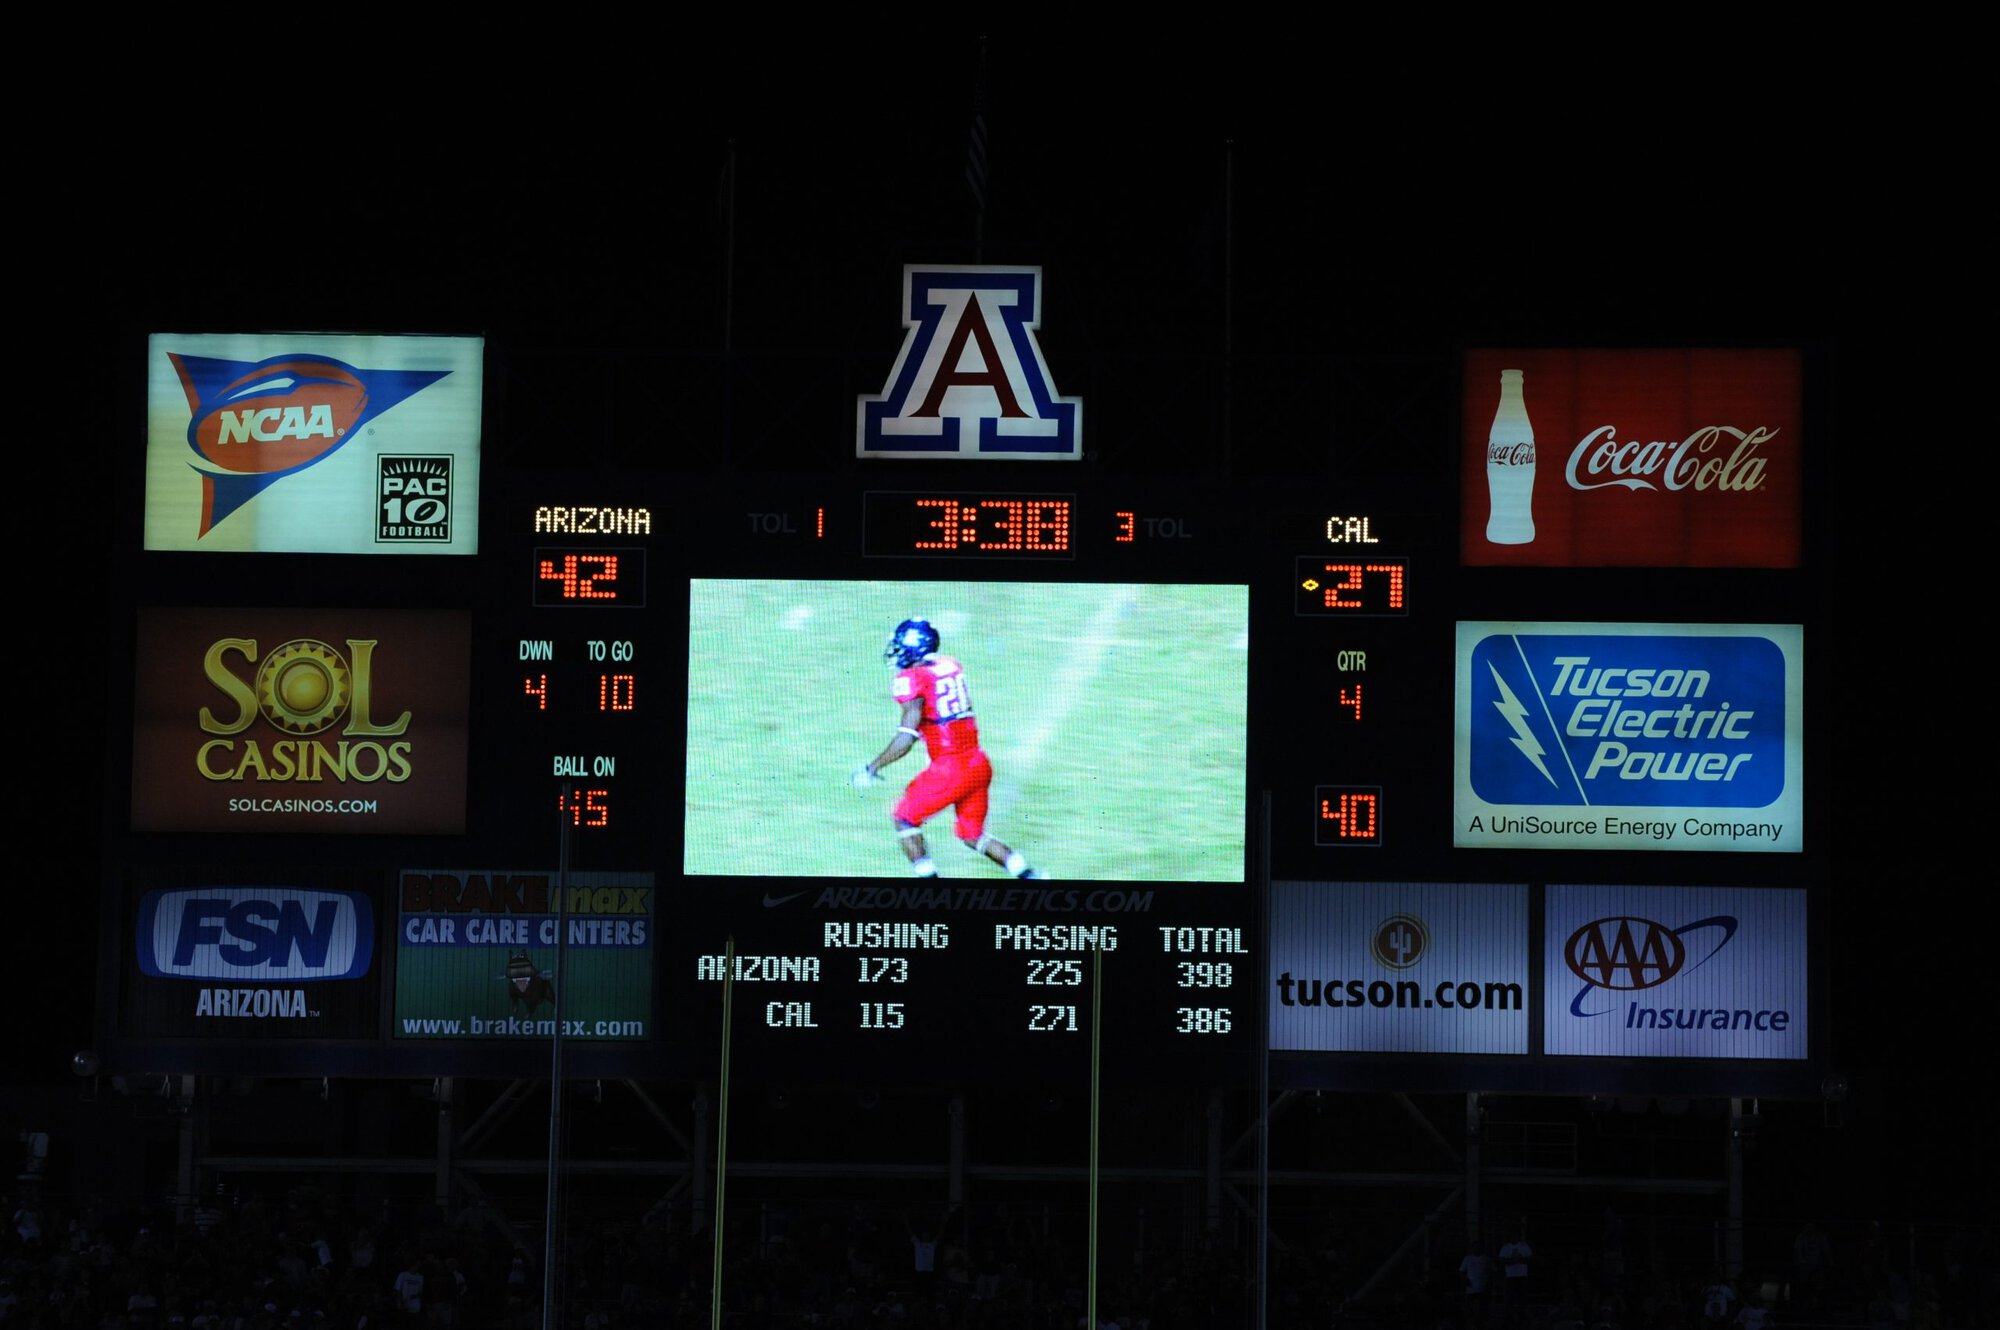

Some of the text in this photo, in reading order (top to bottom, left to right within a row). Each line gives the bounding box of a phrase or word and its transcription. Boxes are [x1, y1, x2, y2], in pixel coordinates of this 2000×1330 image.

[856, 264, 1083, 461] A
[217, 404, 334, 445] NCAA
[1565, 425, 1780, 492] Coca-Cola
[383, 477, 447, 496] PAC
[383, 498, 447, 525] 10
[534, 506, 651, 535] ARIZONA
[747, 512, 797, 535] TOL
[914, 500, 1069, 551] 3:38
[1115, 511, 1193, 542] 3 TOL
[382, 526, 445, 537] FOOTBALL
[1326, 516, 1379, 544] CAL
[539, 554, 618, 600] 42
[1324, 563, 1404, 609] 27
[519, 640, 554, 661] DWN
[586, 640, 634, 662] TO GO
[1337, 650, 1367, 671] QTR
[199, 637, 413, 736] SOL
[524, 673, 547, 711] 4
[600, 673, 634, 712] 10
[1550, 656, 1711, 698] Tucson
[1340, 683, 1363, 721] 4
[1566, 699, 1756, 740] Electric
[196, 738, 413, 784] CASINOS
[553, 756, 616, 778] BALL ON
[1584, 741, 1754, 782] Power
[229, 798, 378, 814] SOLCASINOS.COM
[1321, 794, 1376, 839] 40
[1469, 816, 1783, 841] A UniSource Energy Company
[812, 886, 1155, 913] ARIZONAATHLETICS.COM
[172, 899, 339, 968] FSN
[406, 918, 456, 944] CAR
[465, 919, 529, 945] CARE
[824, 922, 1248, 954] RUSHING PASSING TOTAL
[1574, 917, 1677, 990] AAA
[698, 955, 1233, 988] ARIZONA 173 225 398
[196, 988, 307, 1018] ARIZONA
[1277, 972, 1522, 1010] tucson.com
[403, 1016, 644, 1037] www.brakemax.com
[766, 1001, 1232, 1034] CAL 115 271 386
[1627, 1002, 1790, 1031] Insurance
